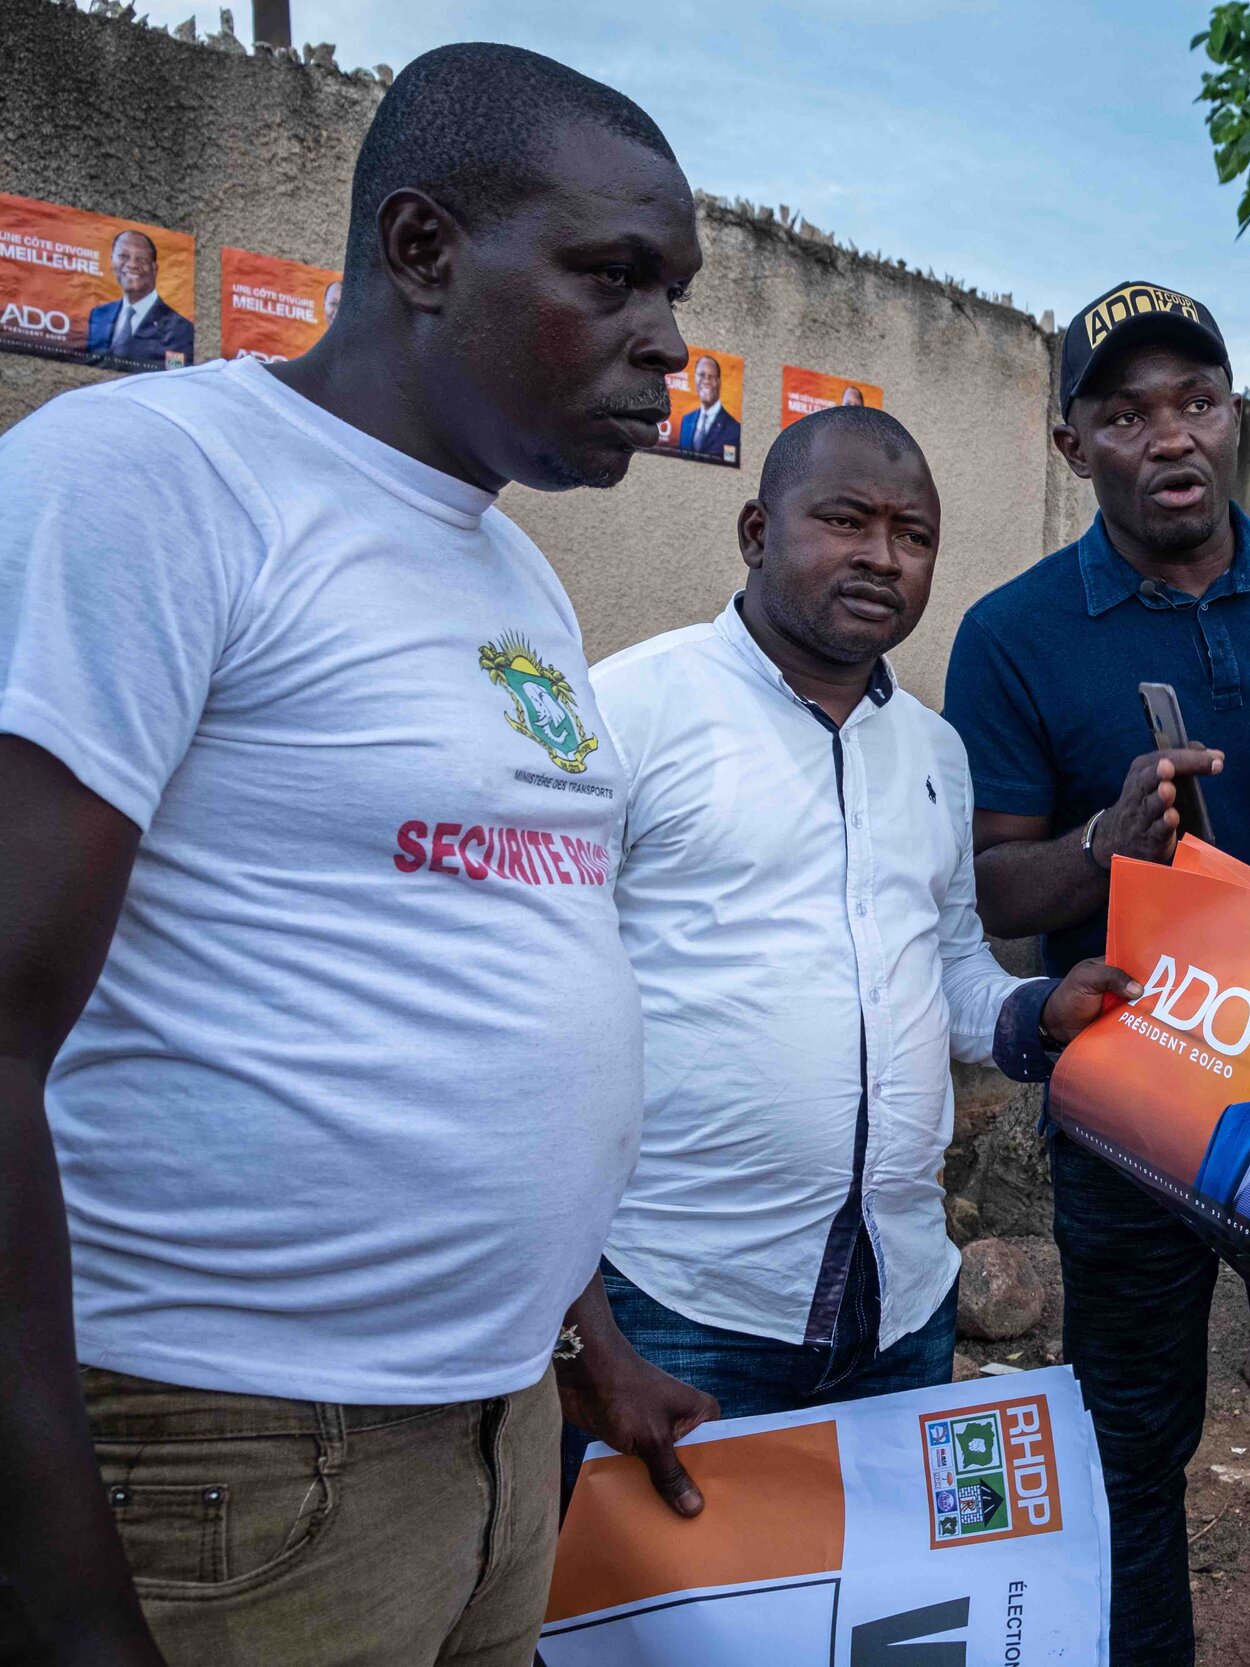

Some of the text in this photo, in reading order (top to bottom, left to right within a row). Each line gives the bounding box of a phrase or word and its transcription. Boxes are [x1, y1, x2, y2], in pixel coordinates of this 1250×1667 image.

[0, 243, 104, 276] MEILLEURE.
[0, 303, 70, 335] ADO
[232, 294, 318, 324] MEILLEURE.
[1091, 288, 1157, 346] ADO
[552, 779, 566, 792] DES
[568, 782, 614, 800] TRANSPORTS
[393, 820, 571, 886] SECURITE
[1118, 1012, 1233, 1080] PRÉSIDENT 20/20
[1006, 1403, 1051, 1527] RHDP
